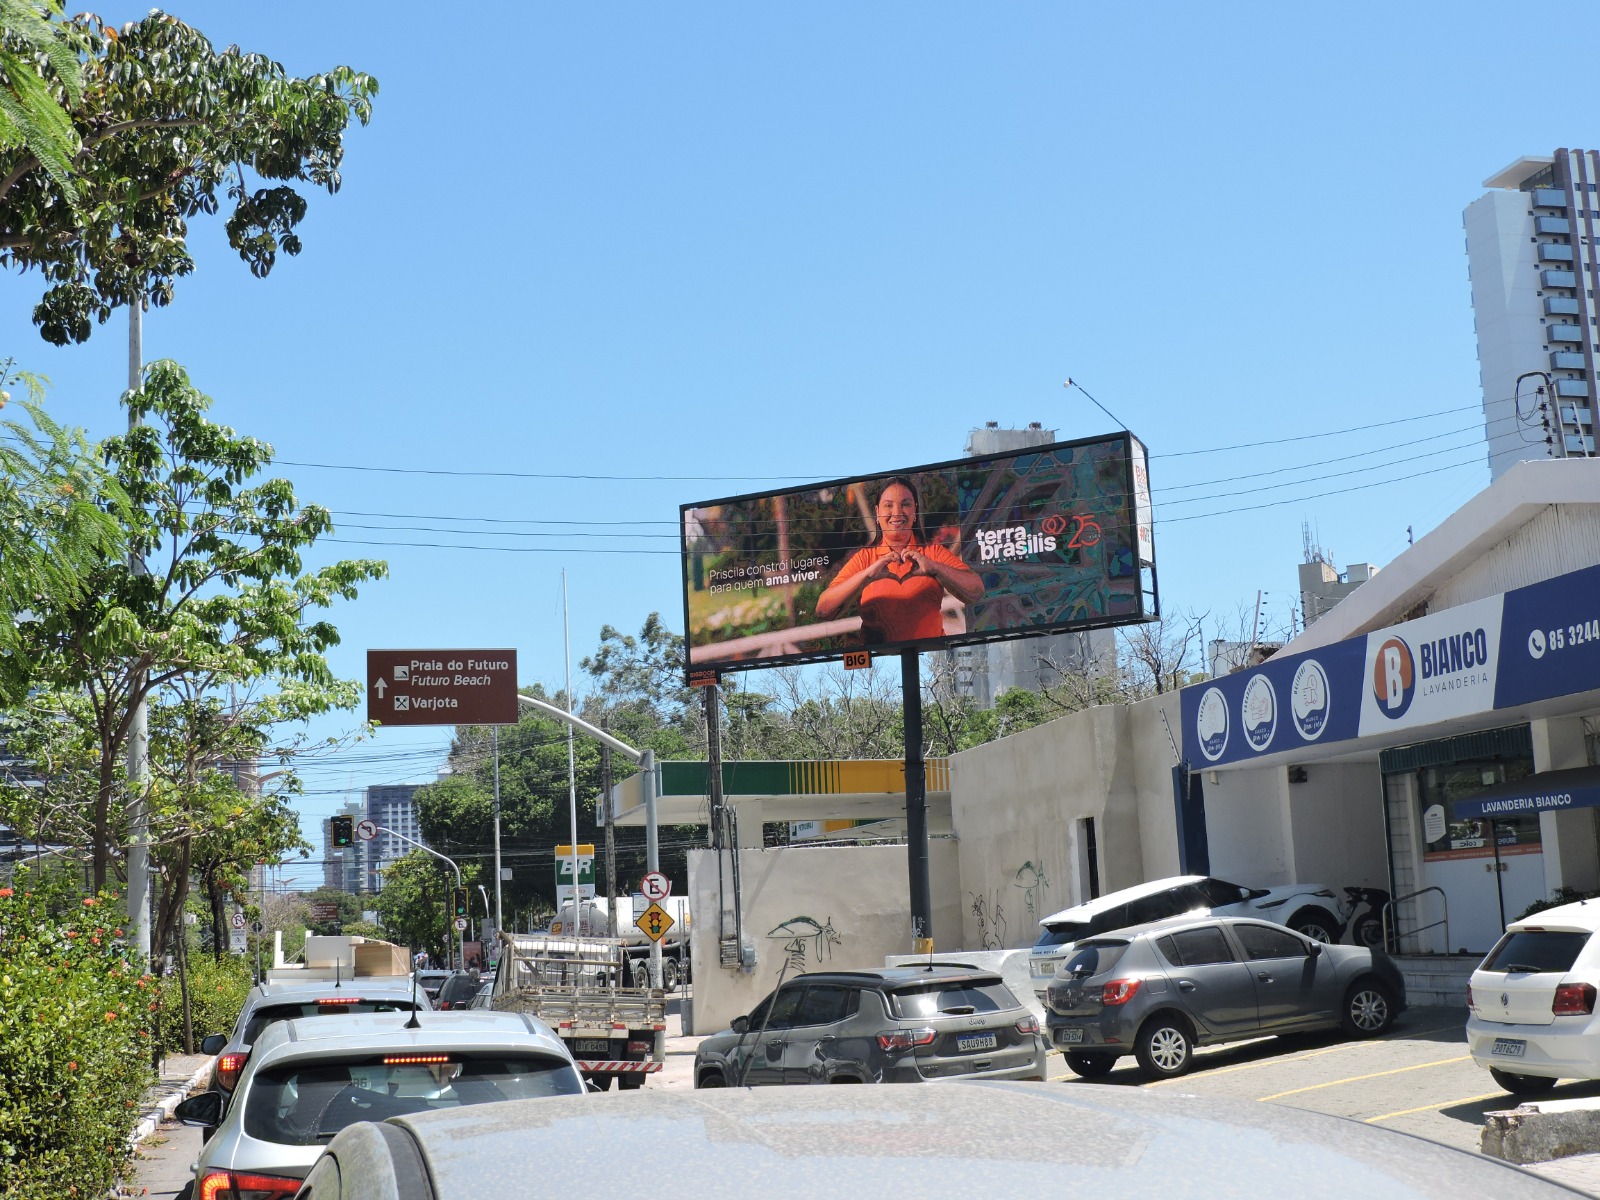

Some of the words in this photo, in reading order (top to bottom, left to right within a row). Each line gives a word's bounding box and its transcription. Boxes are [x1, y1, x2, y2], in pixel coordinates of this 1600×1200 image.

[976, 526, 1026, 544] terra
[1068, 515, 1101, 548] 25
[978, 532, 1056, 561] brasilis
[710, 566, 744, 580] Priscila
[746, 559, 788, 576] constrói
[790, 555, 830, 571] lugares
[710, 584, 732, 597] para
[734, 578, 764, 591] quem
[766, 575, 790, 587] ama
[792, 570, 822, 582] viver.
[1548, 628, 1564, 650] 85
[1568, 619, 1600, 646] 3244
[845, 654, 866, 667] BIG
[1420, 628, 1488, 679] BIANCO
[411, 660, 443, 671] Praia
[447, 660, 464, 671] do
[468, 660, 509, 670] Futuro
[411, 675, 450, 686] Futuro
[454, 675, 491, 686] Beach
[1423, 672, 1488, 697] LAVANDERIA
[412, 697, 458, 711] Varjota
[1482, 798, 1534, 813] LAVANDERIA
[1536, 794, 1572, 808] BIANCO
[560, 859, 591, 874] BR
[650, 878, 659, 894] E
